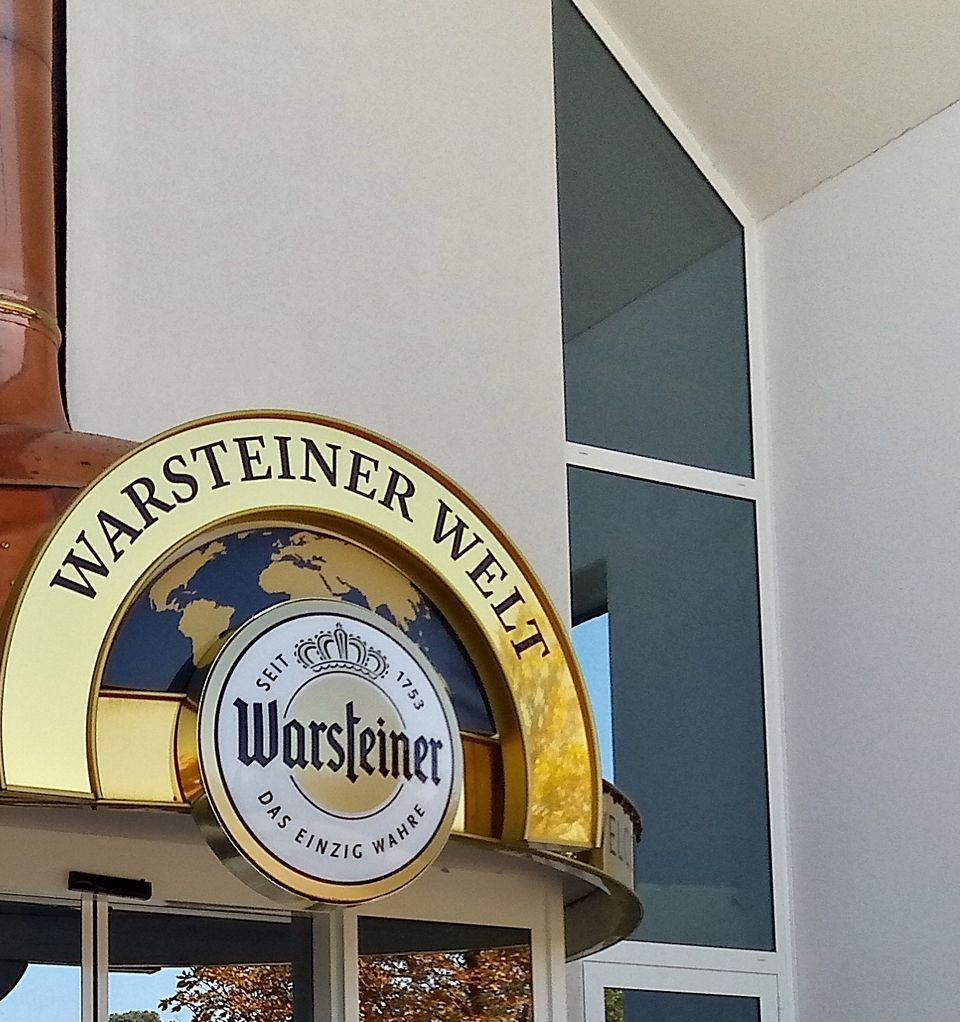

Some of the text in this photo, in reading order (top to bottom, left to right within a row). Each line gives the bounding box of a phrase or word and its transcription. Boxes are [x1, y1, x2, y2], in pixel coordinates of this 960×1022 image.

[50, 435, 550, 662] WARSTEINER WELT
[256, 653, 424, 711] SEIT 1753
[233, 697, 443, 786] Warsteiner
[258, 790, 425, 859] DAS EINZIG WAHRE
